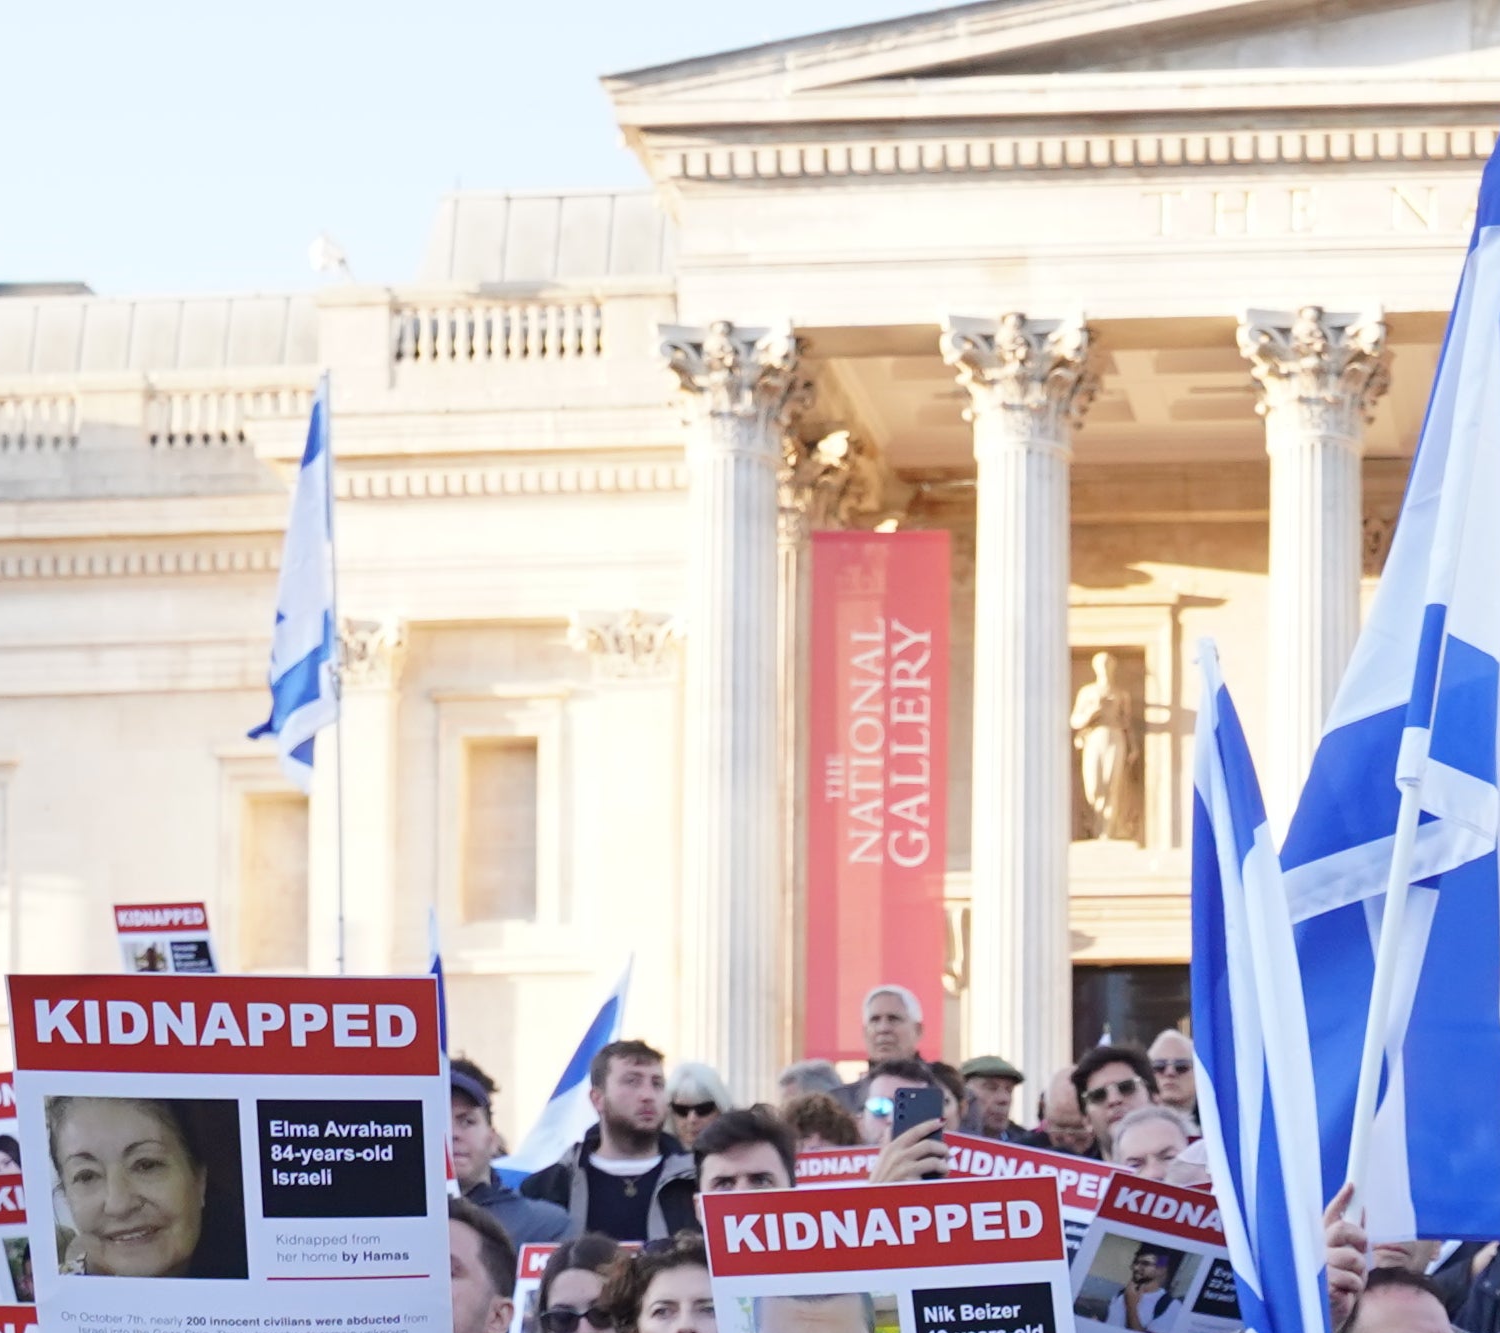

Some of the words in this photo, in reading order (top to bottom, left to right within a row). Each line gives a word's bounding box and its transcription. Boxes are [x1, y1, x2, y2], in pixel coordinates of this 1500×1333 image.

[1142, 187, 1317, 236] THE
[848, 615, 886, 867] NATIONAL
[887, 619, 933, 869] GALLERY
[825, 753, 847, 801] THE
[34, 999, 417, 1048] KIDNAPPED
[269, 1120, 320, 1138] Elma
[324, 1120, 412, 1138] Avraham
[271, 1144, 393, 1166] 84-years-old
[272, 1168, 332, 1186] Israeli
[276, 1234, 348, 1247] Kidnapped
[352, 1233, 381, 1245] from
[724, 1200, 1043, 1252] KIDNAPPED
[923, 1305, 956, 1323] Nik
[959, 1303, 1021, 1321] Beizer
